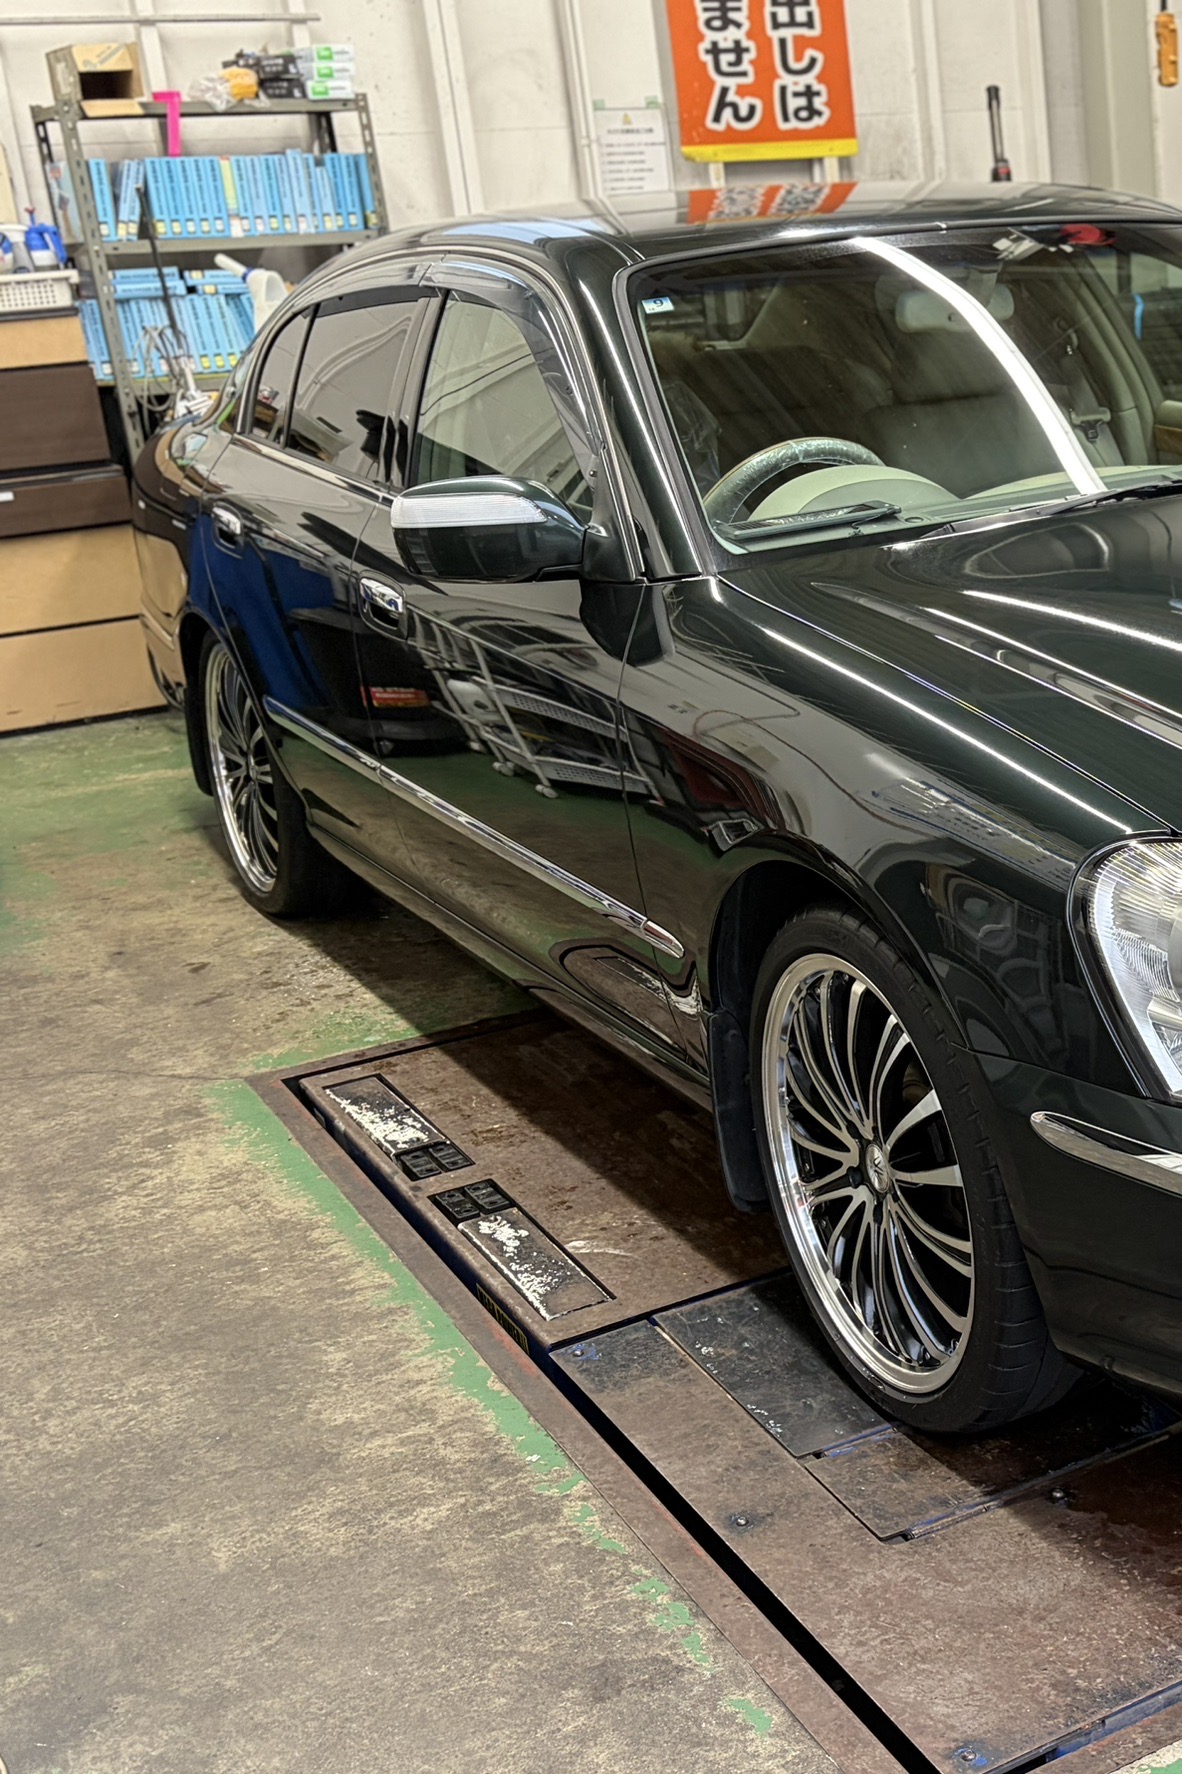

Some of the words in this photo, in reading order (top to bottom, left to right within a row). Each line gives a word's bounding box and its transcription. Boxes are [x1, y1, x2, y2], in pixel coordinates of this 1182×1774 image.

[701, 0, 756, 124] ません
[769, 0, 826, 123] 出しは
